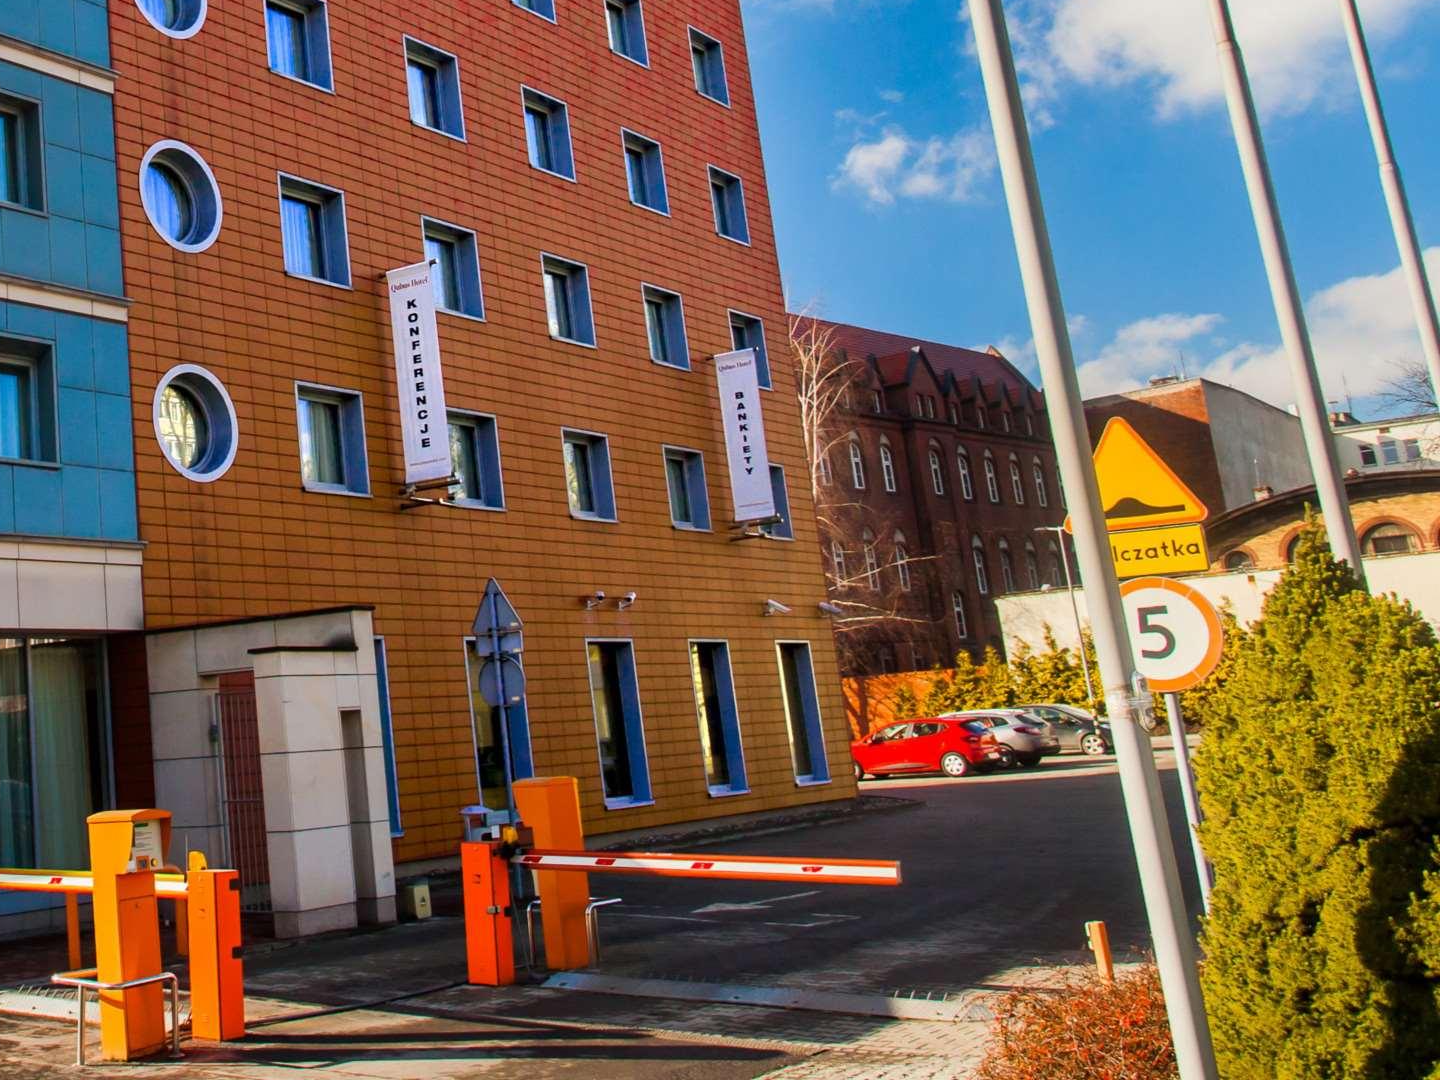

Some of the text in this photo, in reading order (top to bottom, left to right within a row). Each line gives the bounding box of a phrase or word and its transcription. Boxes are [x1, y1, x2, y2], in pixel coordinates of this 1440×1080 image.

[406, 298, 431, 448] KONFERENCJE
[734, 391, 755, 476] BANKIETY
[1112, 539, 1201, 563] lczatka
[1135, 604, 1177, 661] 5
